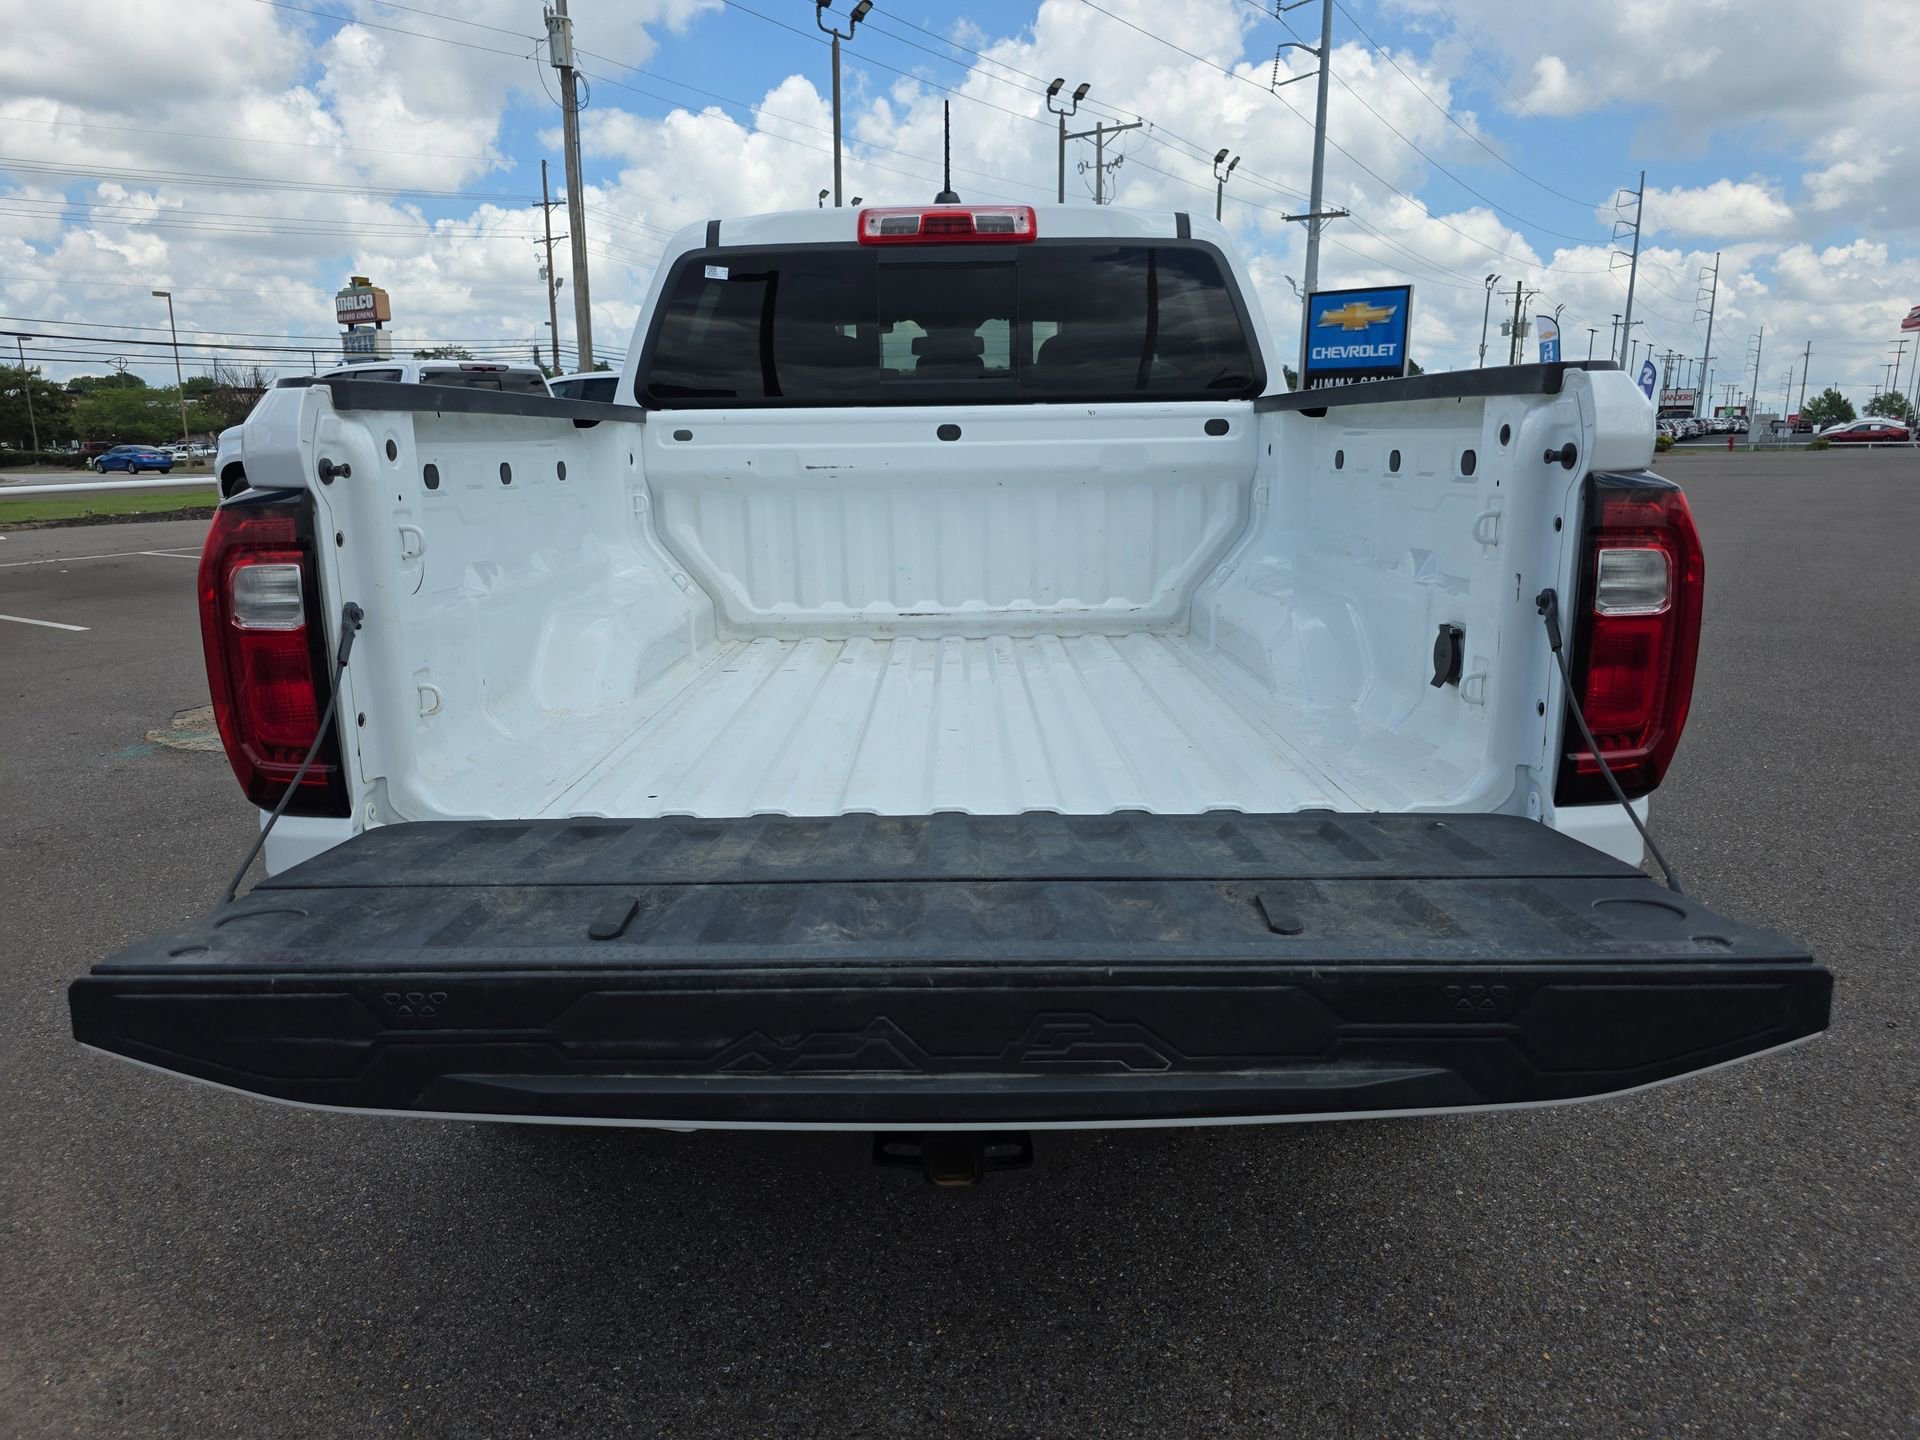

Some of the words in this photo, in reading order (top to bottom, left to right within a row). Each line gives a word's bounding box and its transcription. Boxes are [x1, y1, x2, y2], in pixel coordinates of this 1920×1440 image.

[336, 294, 374, 312] MALCO
[1312, 344, 1397, 359] CHEVROLET
[1311, 377, 1353, 390] JIMMY
[1661, 393, 1693, 401] LANDERS
